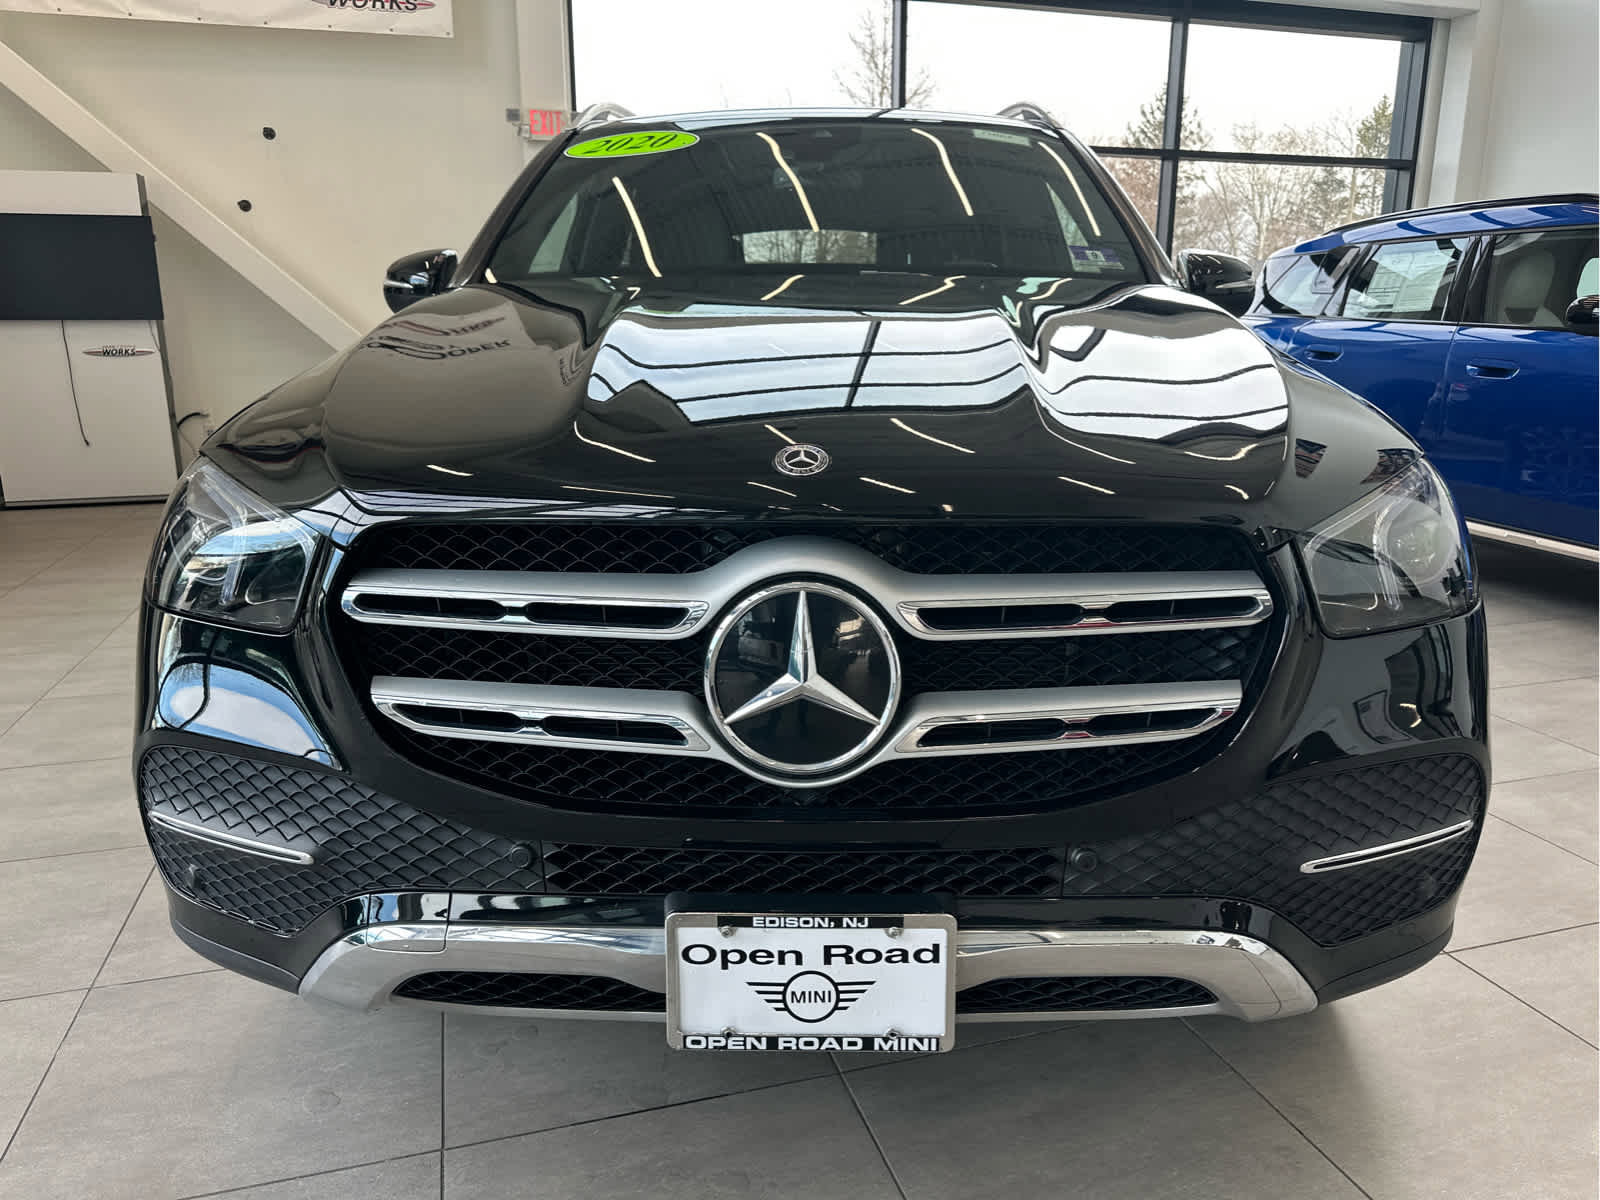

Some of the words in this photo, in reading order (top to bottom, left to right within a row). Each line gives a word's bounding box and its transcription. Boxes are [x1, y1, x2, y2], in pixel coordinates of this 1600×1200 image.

[529, 109, 562, 136] EXIT
[582, 133, 678, 154] 2020
[103, 348, 137, 357] WORKS
[752, 917, 835, 928] EDISON,
[842, 917, 869, 928] NJ
[681, 943, 803, 970] Open
[823, 943, 941, 966] Road
[790, 990, 832, 1004] MINI
[685, 1036, 768, 1050] OPEN
[777, 1037, 863, 1051] ROAD
[873, 1037, 937, 1051] MINI
